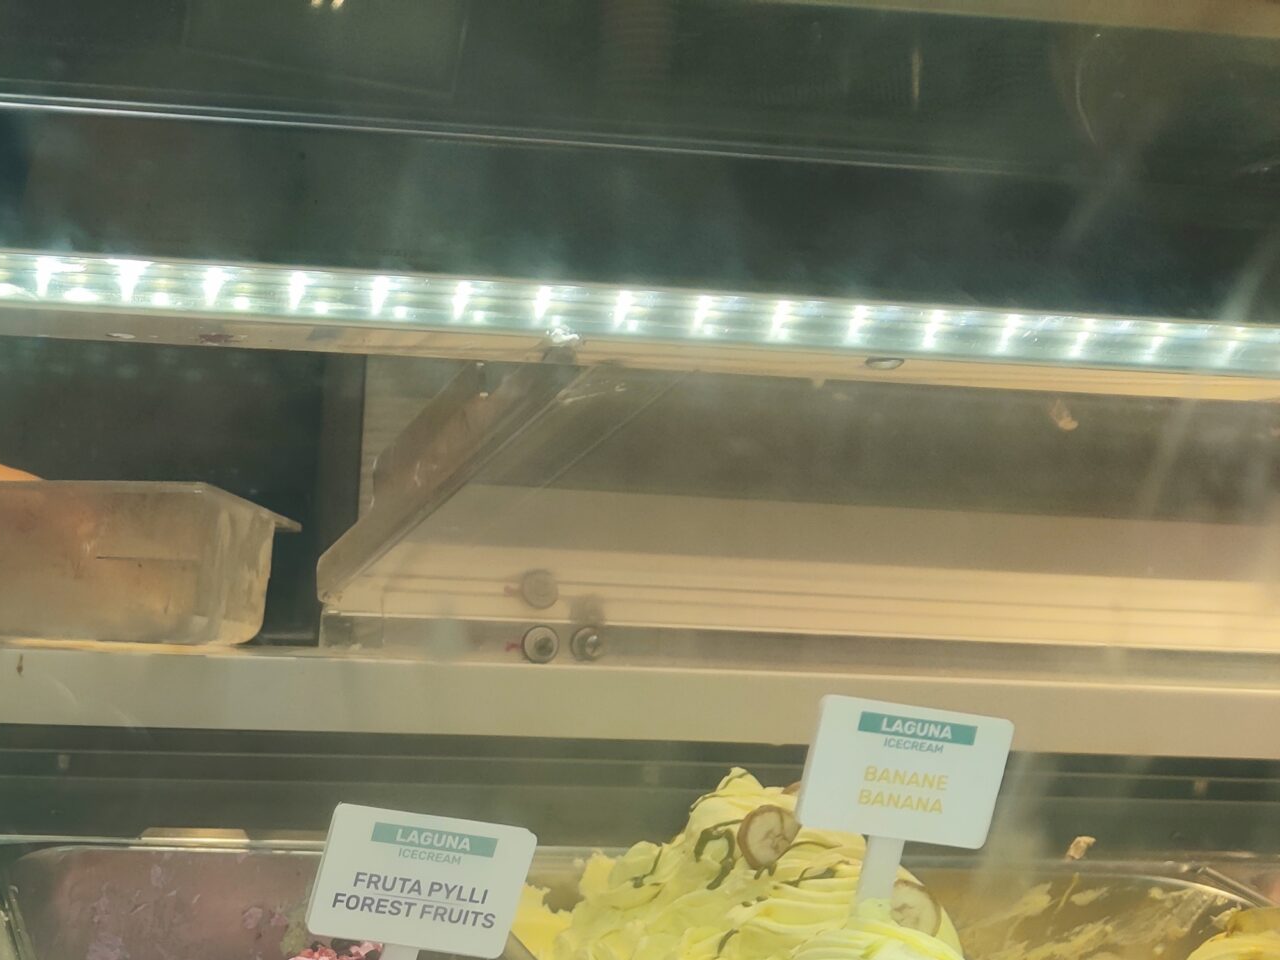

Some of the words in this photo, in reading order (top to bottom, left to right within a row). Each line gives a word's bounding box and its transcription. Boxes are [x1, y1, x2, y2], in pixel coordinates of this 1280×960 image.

[880, 717, 952, 739] LAGUNA
[883, 737, 944, 753] ICECREAM
[863, 765, 949, 790] BANANE
[857, 789, 943, 814] BANANA
[395, 828, 470, 851] LAGUNA
[398, 848, 461, 864] ICECREAM
[353, 872, 422, 895] FRUTA
[427, 882, 488, 904] PYLLI
[332, 892, 416, 918] FOREST
[419, 904, 496, 928] FRUITS
